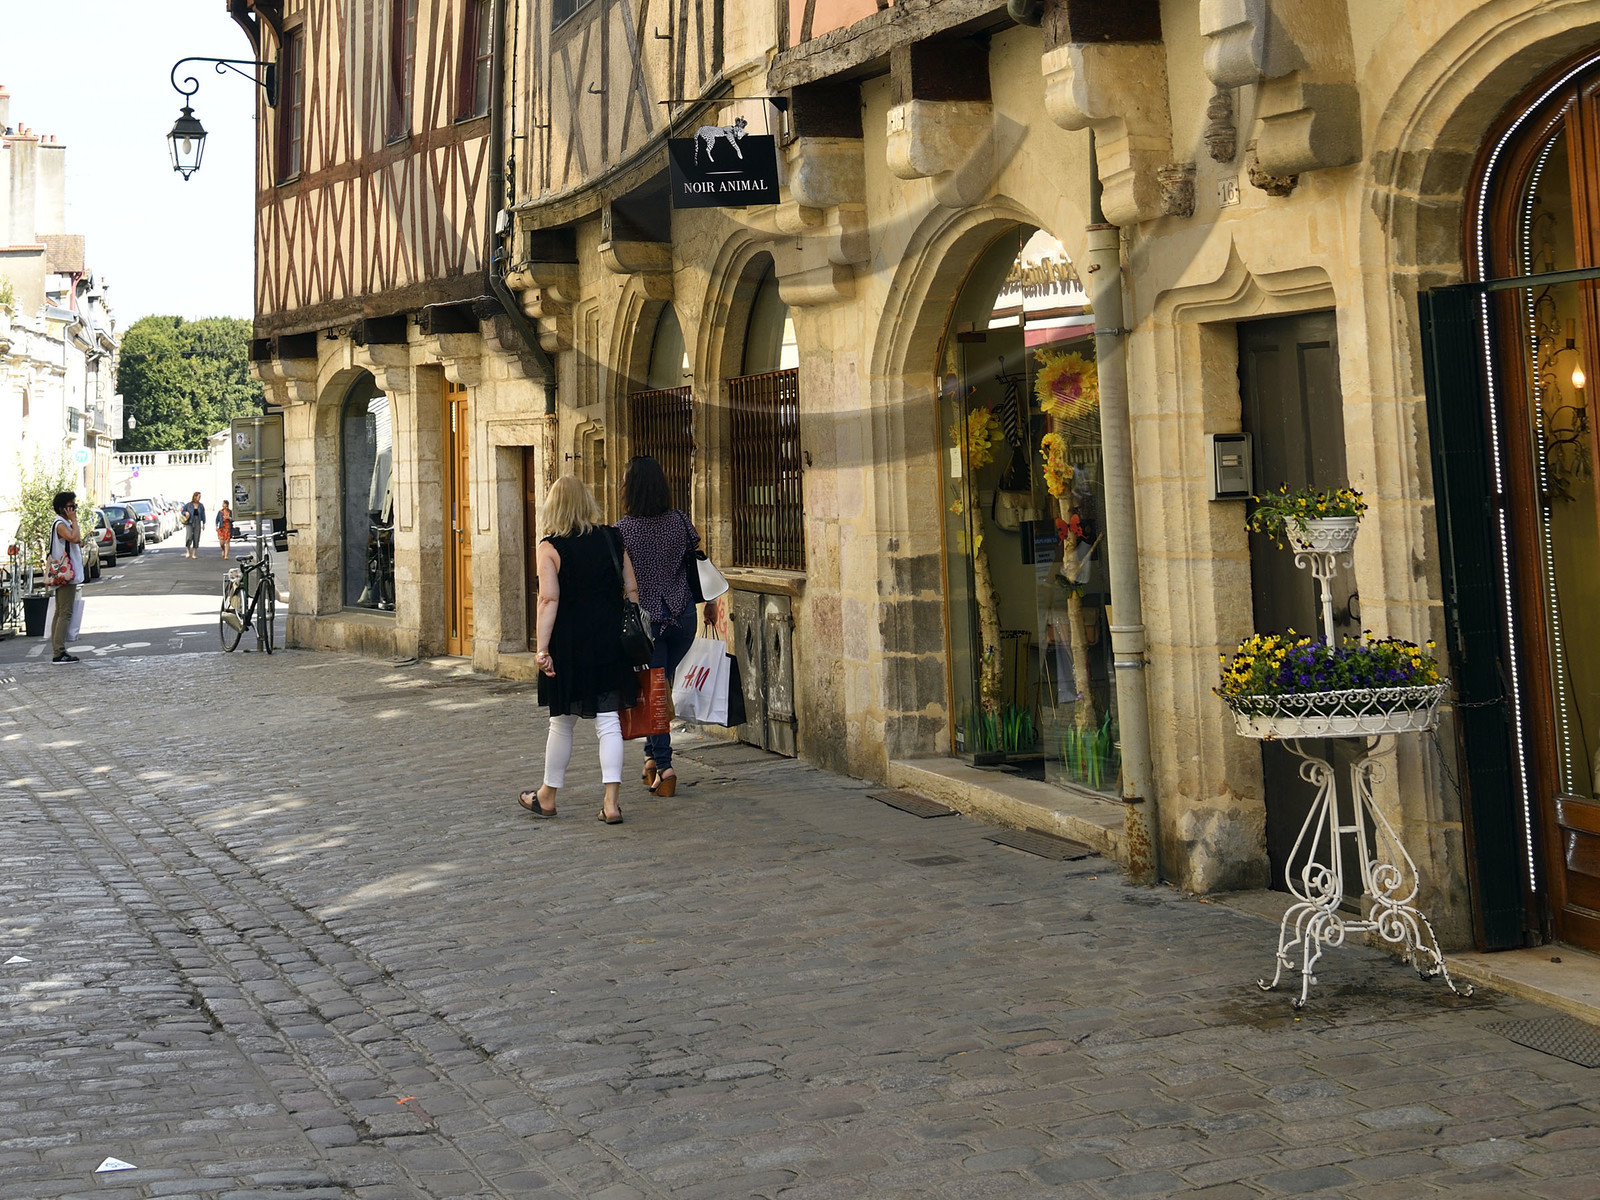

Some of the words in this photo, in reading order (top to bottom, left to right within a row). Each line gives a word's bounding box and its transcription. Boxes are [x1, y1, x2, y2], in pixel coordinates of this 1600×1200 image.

[684, 181, 715, 194] NOIR
[719, 179, 768, 192] ANIMAL
[1221, 181, 1235, 202] 16
